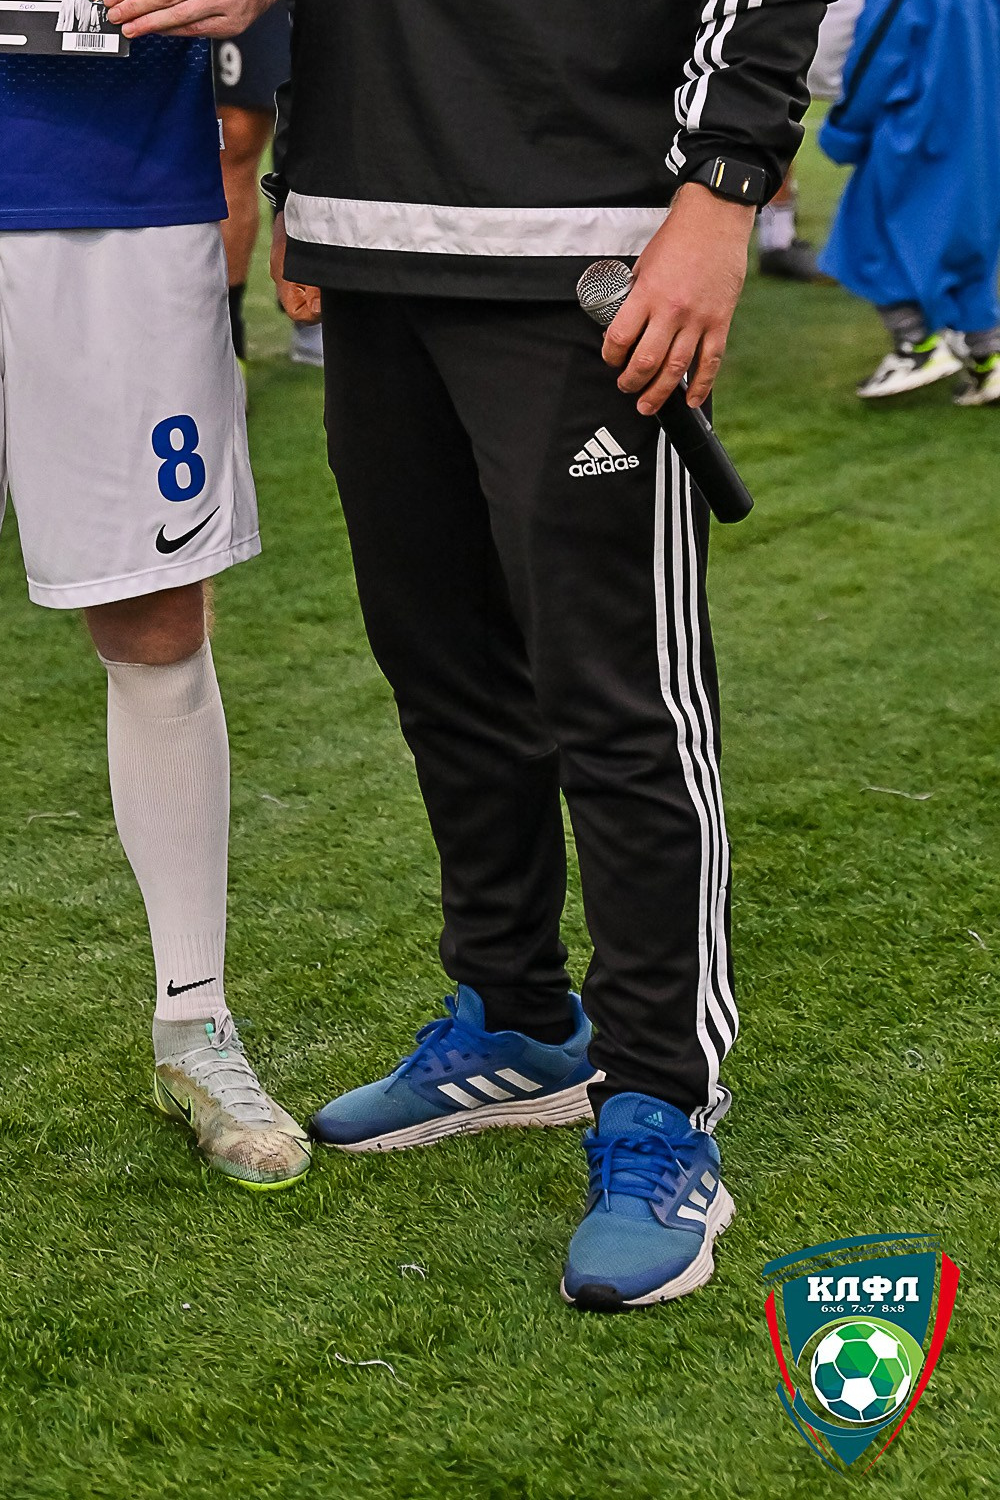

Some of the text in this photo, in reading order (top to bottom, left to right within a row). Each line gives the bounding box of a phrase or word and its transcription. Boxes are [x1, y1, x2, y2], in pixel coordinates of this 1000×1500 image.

[219, 41, 242, 87] 9
[151, 414, 206, 502] 8
[568, 455, 640, 477] adidas
